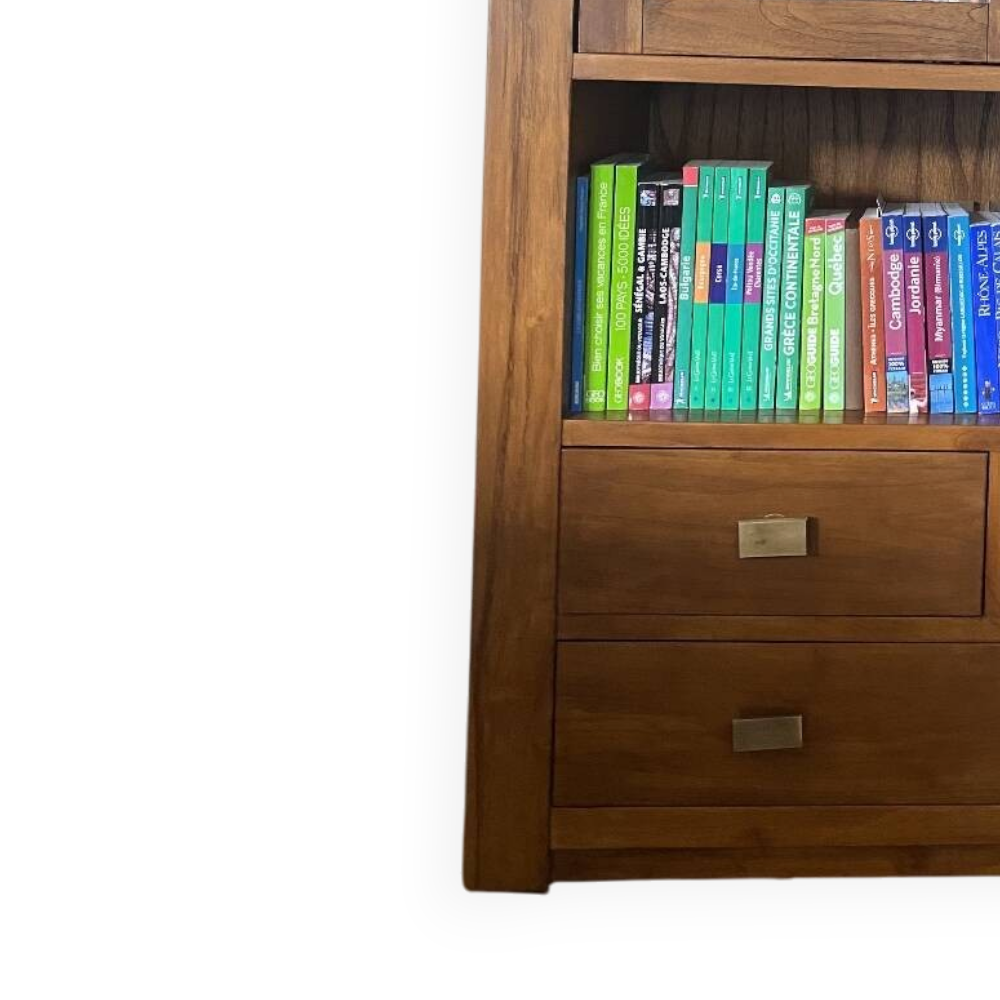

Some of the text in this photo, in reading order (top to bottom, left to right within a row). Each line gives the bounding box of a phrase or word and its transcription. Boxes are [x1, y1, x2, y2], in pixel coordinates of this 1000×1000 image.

[598, 181, 608, 219] France
[599, 222, 606, 235] en
[637, 228, 647, 263] GAMBIE
[810, 237, 821, 268] Nord
[596, 238, 606, 287] vacances
[614, 206, 630, 332] 100 PAYS 5000 IDÉES
[658, 227, 670, 304] LAOS-CAMBODGE
[680, 255, 692, 301] Bulgarie
[763, 210, 780, 351] GRANDS SITES D'OCCITANIE
[785, 210, 800, 310] CONTINENTALE
[828, 235, 843, 296] Québec
[975, 229, 992, 317] RHÔNE-ALPES
[596, 291, 604, 309] ses
[634, 274, 645, 313] SÉNÉGAL
[806, 268, 823, 325] Bretagne
[887, 252, 903, 331] Cambodge
[907, 256, 922, 315] Jordanie
[781, 312, 797, 356] GRÈCE
[933, 295, 946, 342] Myanmar
[591, 348, 602, 372] Bien
[829, 328, 840, 390] GEOGUIDE
